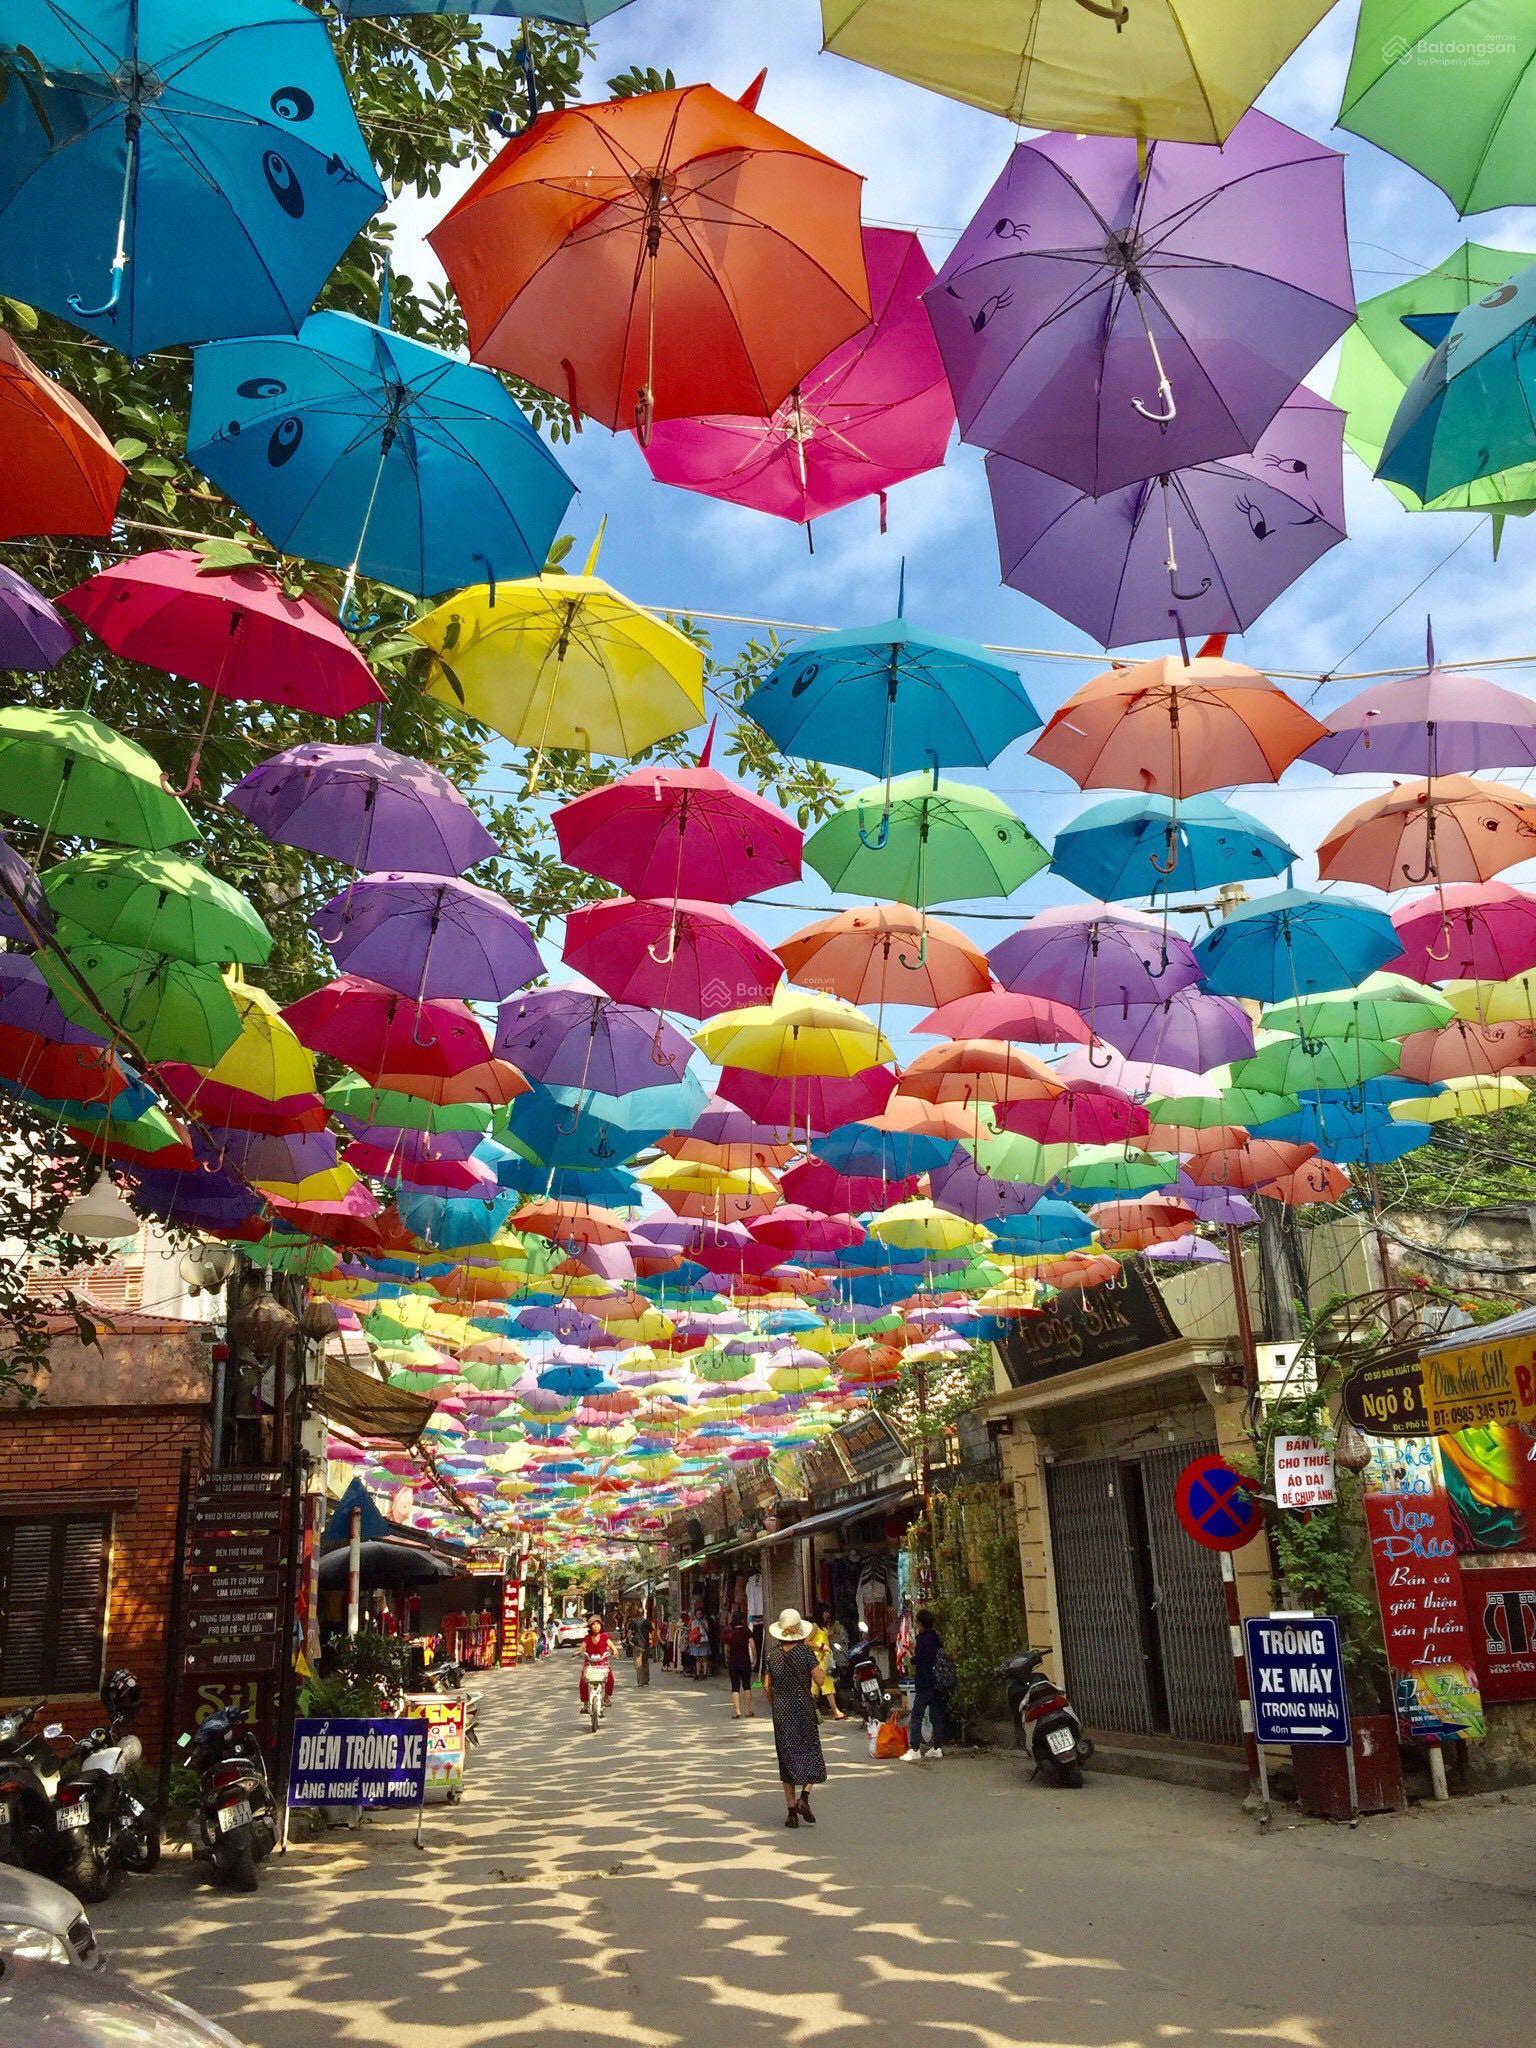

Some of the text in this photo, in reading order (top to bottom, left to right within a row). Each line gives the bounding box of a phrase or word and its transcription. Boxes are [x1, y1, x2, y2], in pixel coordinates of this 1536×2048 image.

[1361, 1387, 1399, 1423] Ngõ
[1403, 1386, 1415, 1412] 8
[1477, 1402, 1496, 1420] 345
[1498, 1400, 1518, 1417] 672
[1286, 1437, 1310, 1451] BÁN
[1278, 1452, 1331, 1470] CHO THUÊ
[1288, 1472, 1324, 1488] ÁO DÀI
[1384, 1501, 1435, 1534] Vạn
[1389, 1566, 1451, 1587] Bán và
[1390, 1590, 1458, 1616] giới thiệu
[1259, 1625, 1326, 1655] TRÔNG
[1391, 1616, 1464, 1640] sản phẩm
[1411, 1643, 1453, 1667] Lụa
[1259, 1663, 1333, 1694] XE MÁY
[407, 1704, 462, 1724] KEM
[1262, 1699, 1339, 1720] (TRONG NHÀ)
[1270, 1726, 1289, 1734] 40m
[298, 1722, 423, 1770] ĐIỂM TRÔNG XE
[294, 1776, 418, 1802] LÀNG NGHỀ VẠN PHÚC
